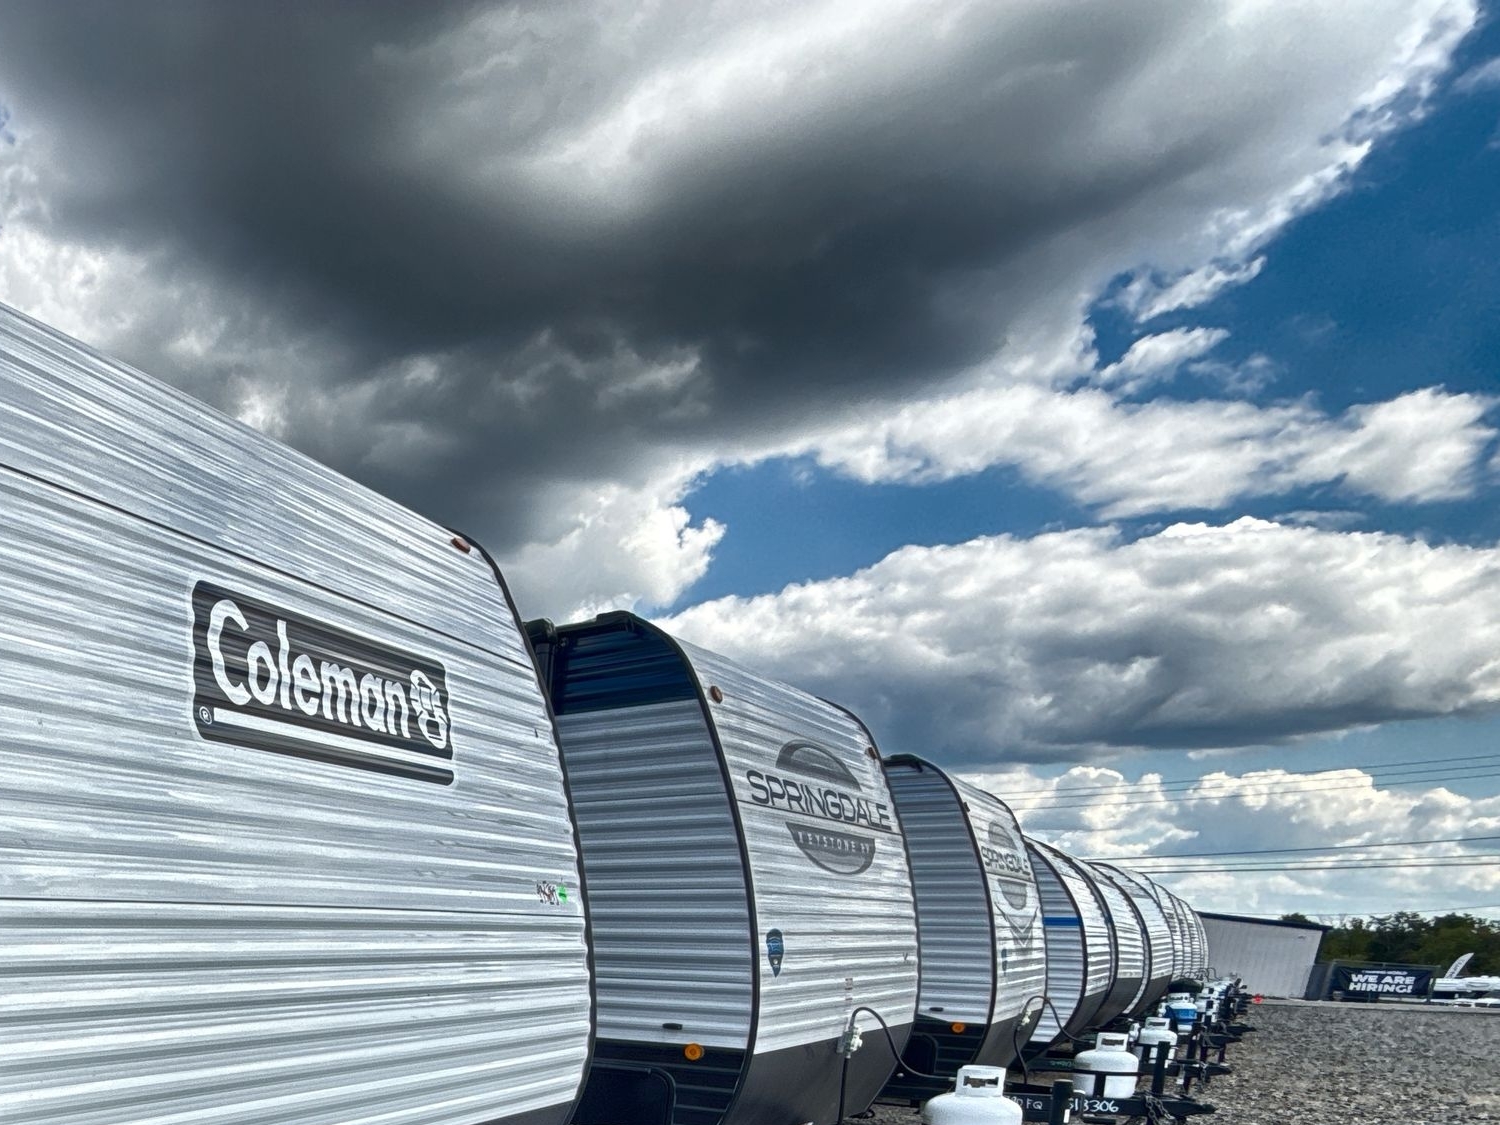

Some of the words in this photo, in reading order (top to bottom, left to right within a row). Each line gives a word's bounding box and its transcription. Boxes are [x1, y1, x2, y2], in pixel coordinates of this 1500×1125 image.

[206, 599, 411, 739] Coleman
[746, 769, 892, 831] SPRINGDALE
[797, 831, 856, 852] KEYSTONE
[1348, 982, 1414, 993] HIRING!
[1351, 974, 1378, 983] WE
[1381, 975, 1416, 985] ARE
